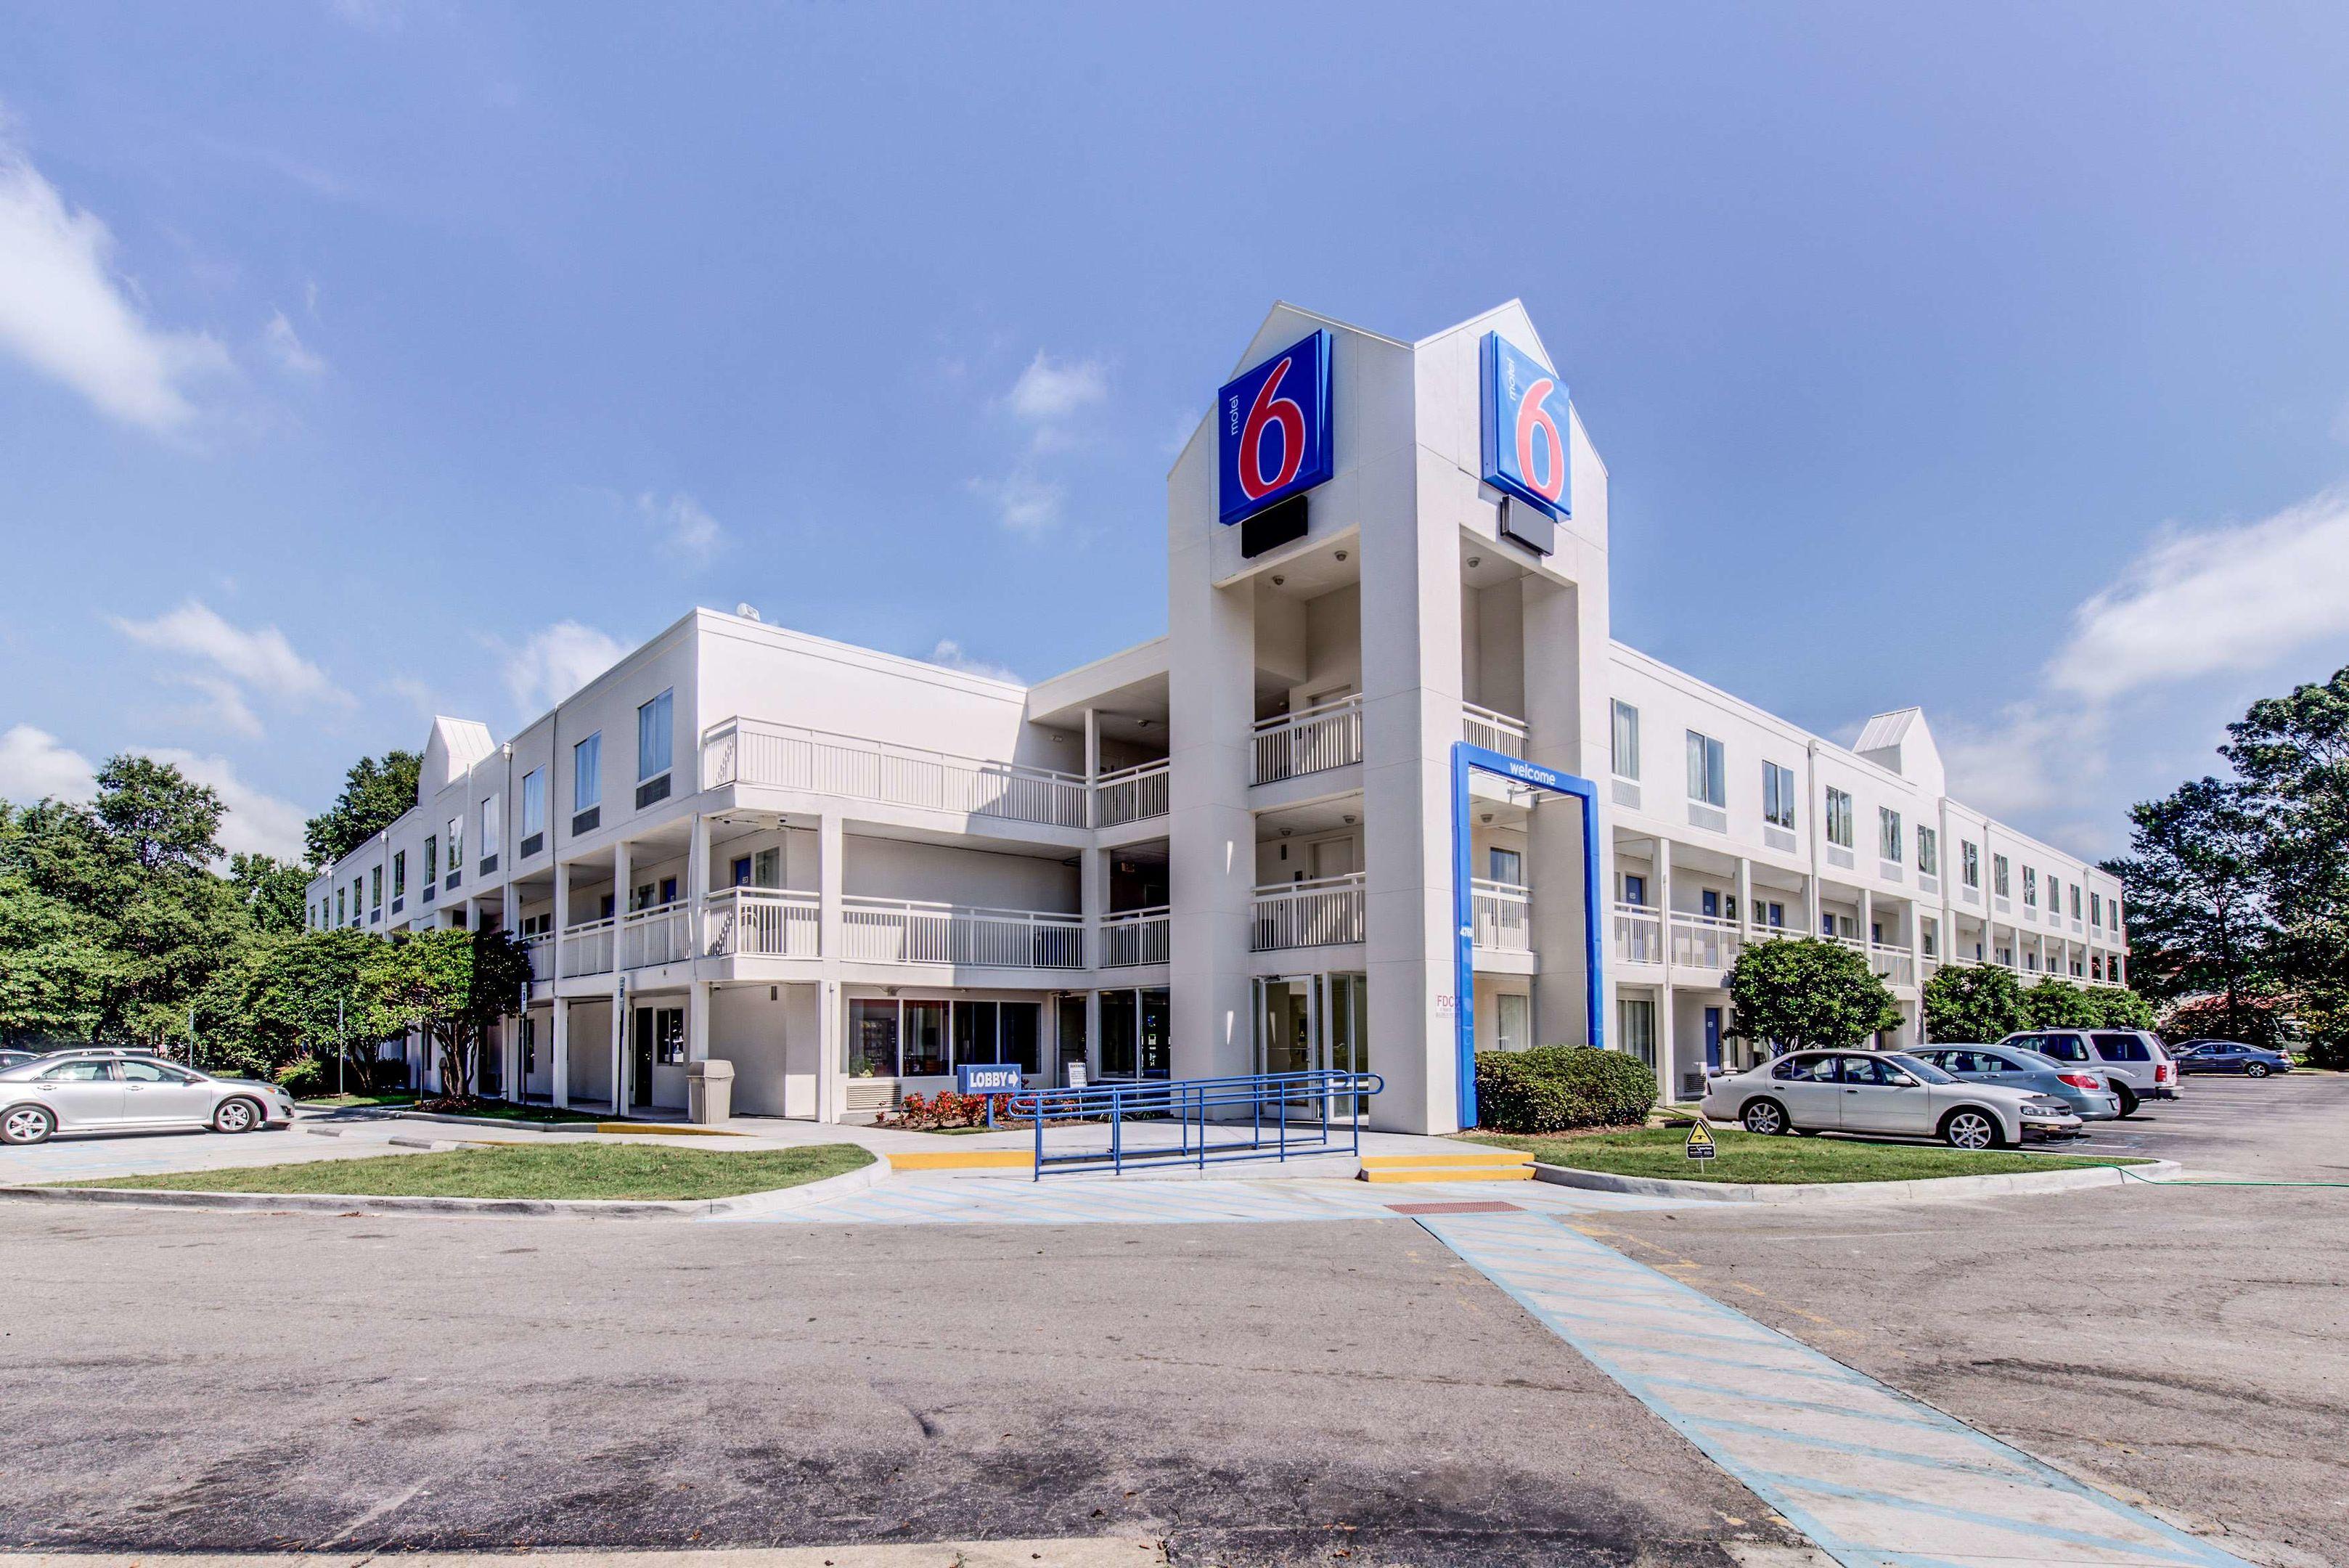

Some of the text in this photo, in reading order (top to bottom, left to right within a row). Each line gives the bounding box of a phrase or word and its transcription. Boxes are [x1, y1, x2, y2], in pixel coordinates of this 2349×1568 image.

[1506, 357, 1516, 401] motel
[1230, 394, 1238, 436] motel
[1238, 356, 1306, 501] 6
[1516, 377, 1564, 502] 6
[1510, 762, 1556, 785] welcome
[1437, 995, 1454, 1007] FDC
[970, 1071, 1008, 1087] LOBBY
